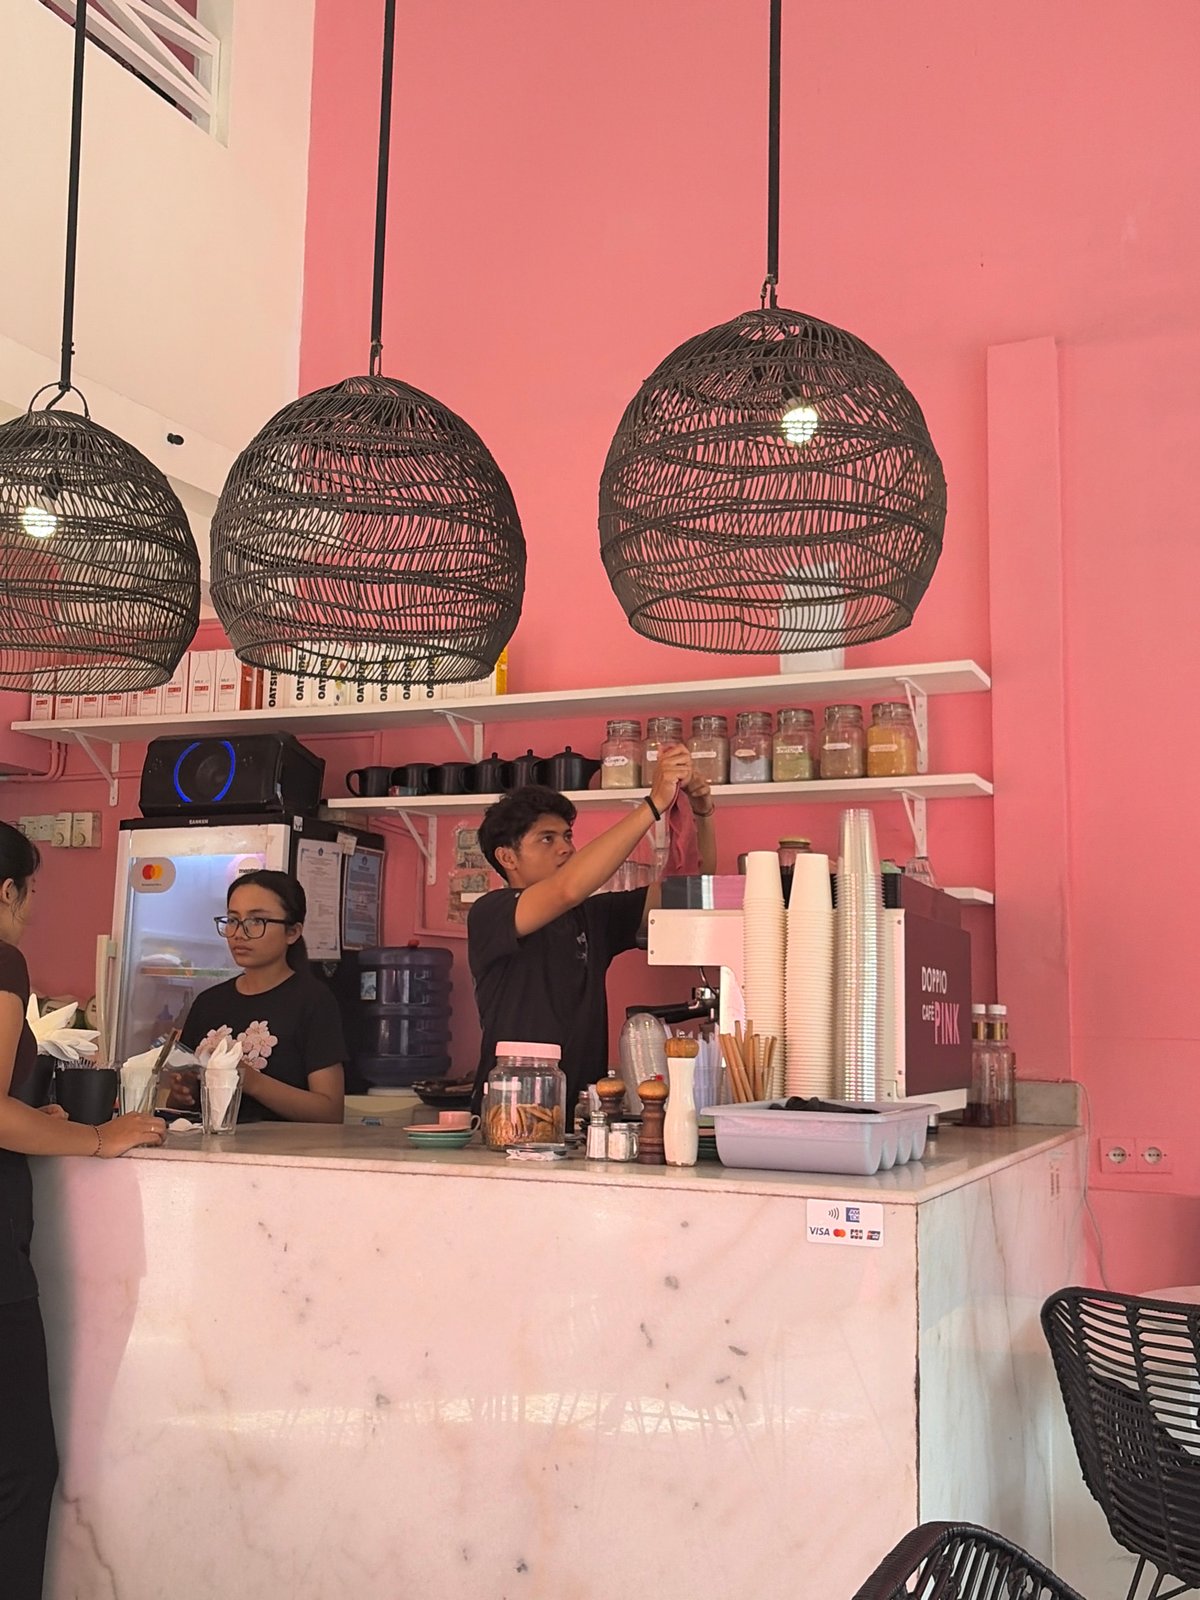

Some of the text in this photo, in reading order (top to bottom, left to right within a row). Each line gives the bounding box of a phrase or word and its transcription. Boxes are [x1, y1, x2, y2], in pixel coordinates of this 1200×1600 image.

[268, 663, 279, 707] OATSI
[922, 966, 947, 994] DOPPIO
[922, 1001, 960, 1045] CAFÉ PINK
[809, 1227, 830, 1236] VISA
